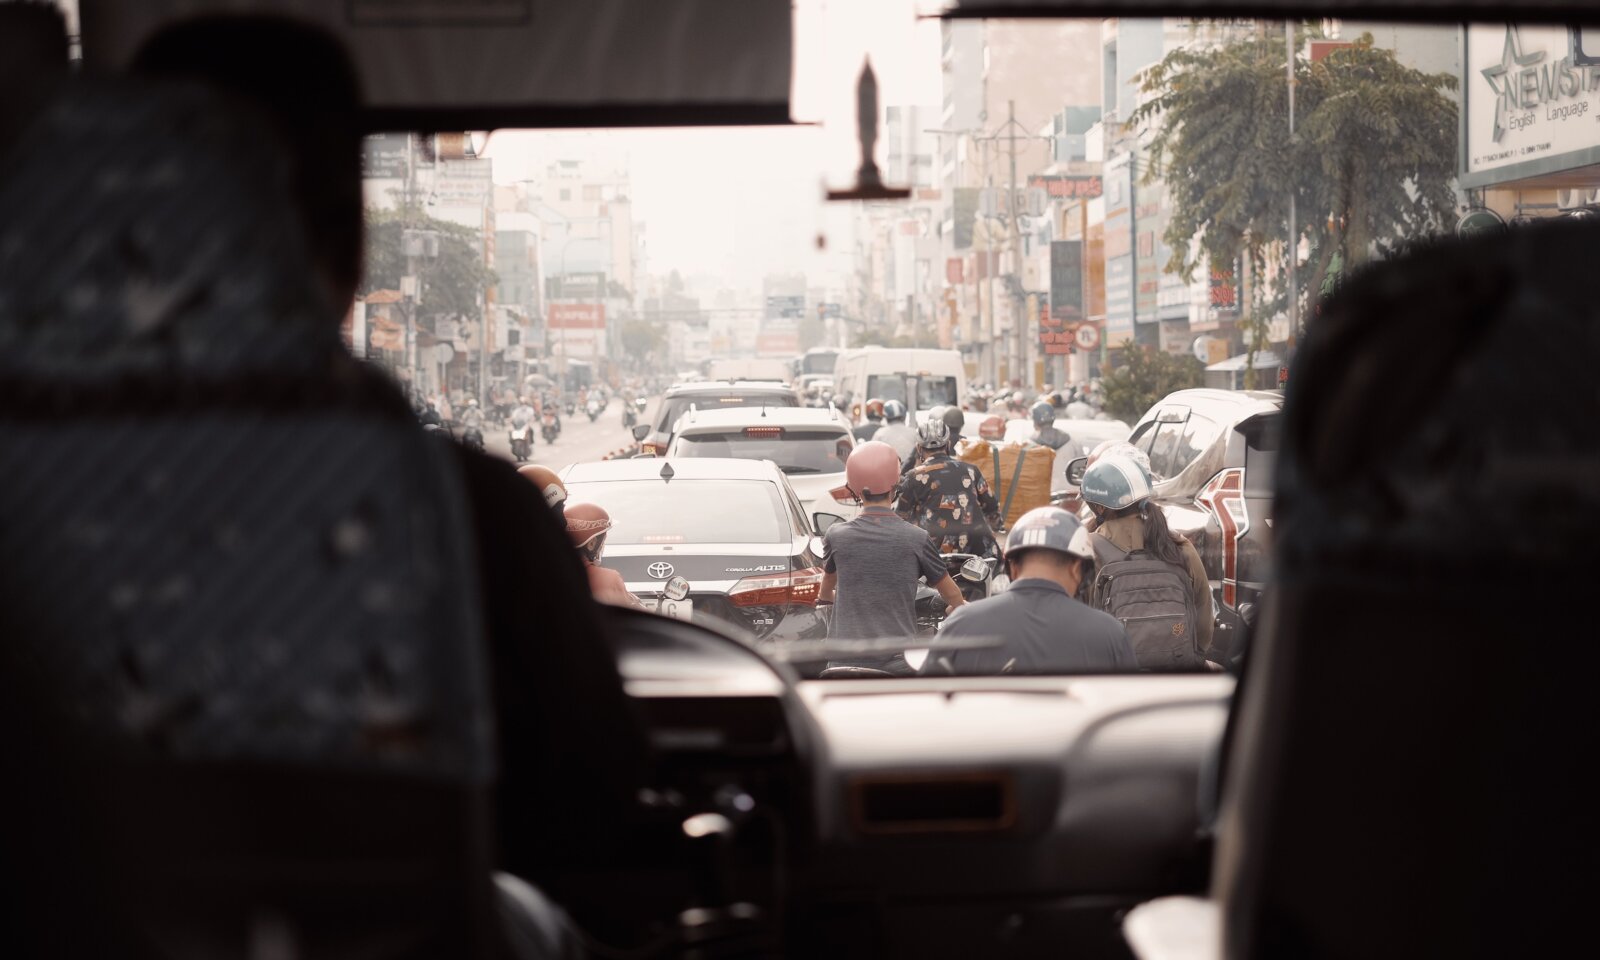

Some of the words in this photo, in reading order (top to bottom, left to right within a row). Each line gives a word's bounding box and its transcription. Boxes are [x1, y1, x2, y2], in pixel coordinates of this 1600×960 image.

[1504, 56, 1600, 111] NEWST
[1509, 111, 1536, 131] English
[1546, 101, 1589, 121] Language
[754, 564, 786, 572] ALTIS
